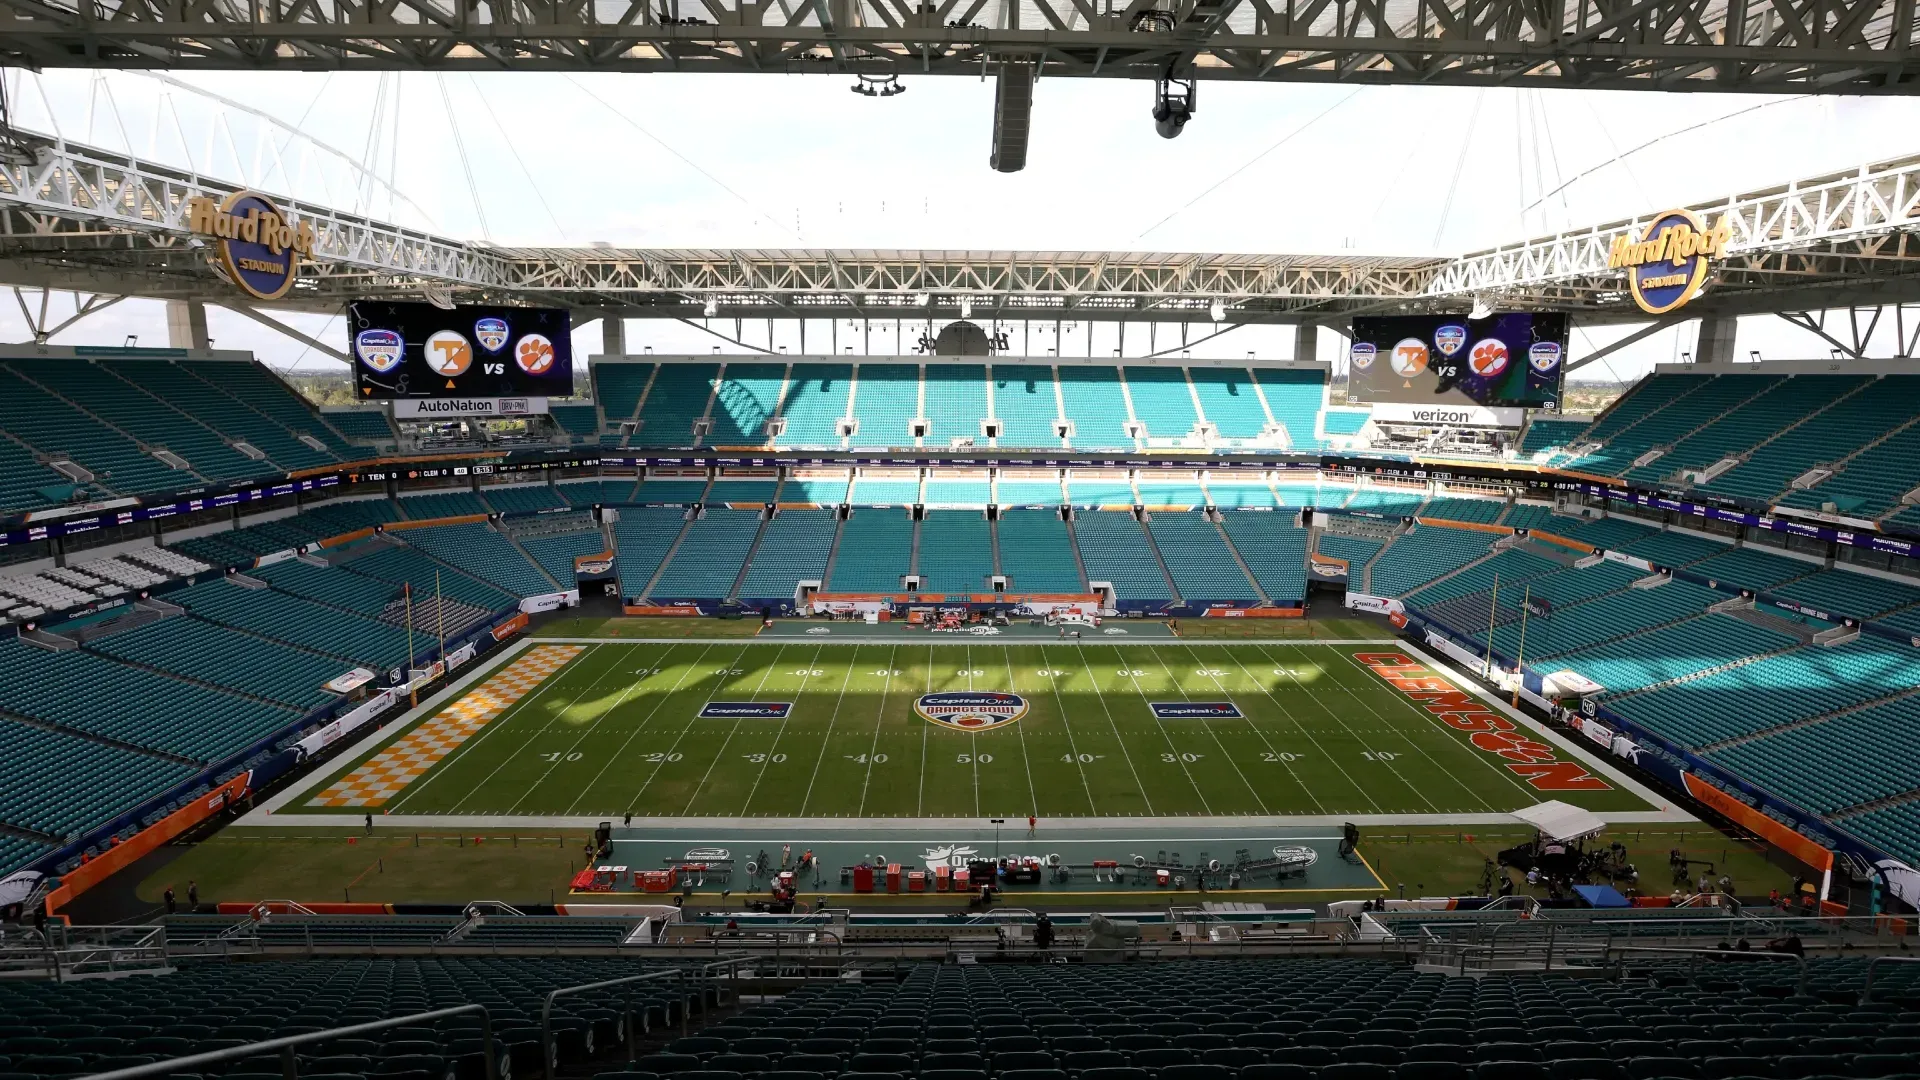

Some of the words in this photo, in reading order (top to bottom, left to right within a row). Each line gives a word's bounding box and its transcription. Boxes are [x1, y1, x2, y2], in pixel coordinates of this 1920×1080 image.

[188, 196, 258, 242] Hard
[257, 211, 318, 260] Rock
[1608, 227, 1671, 268] Hard
[1664, 215, 1733, 267] Rock
[239, 258, 284, 275] STADIUM
[1641, 274, 1687, 290] STADIUM
[418, 400, 492, 414] AutoNation
[1412, 409, 1468, 422] verizon
[424, 469, 438, 477] CLEM
[1584, 701, 1594, 715] 40
[546, 752, 584, 762] 10
[645, 753, 684, 762] 20
[749, 752, 788, 763] 30
[853, 753, 888, 763] 40
[957, 753, 993, 763] 50
[1060, 753, 1094, 763] 40
[1161, 752, 1196, 763] 30
[1260, 752, 1295, 762] 20
[1360, 751, 1395, 761] 10
